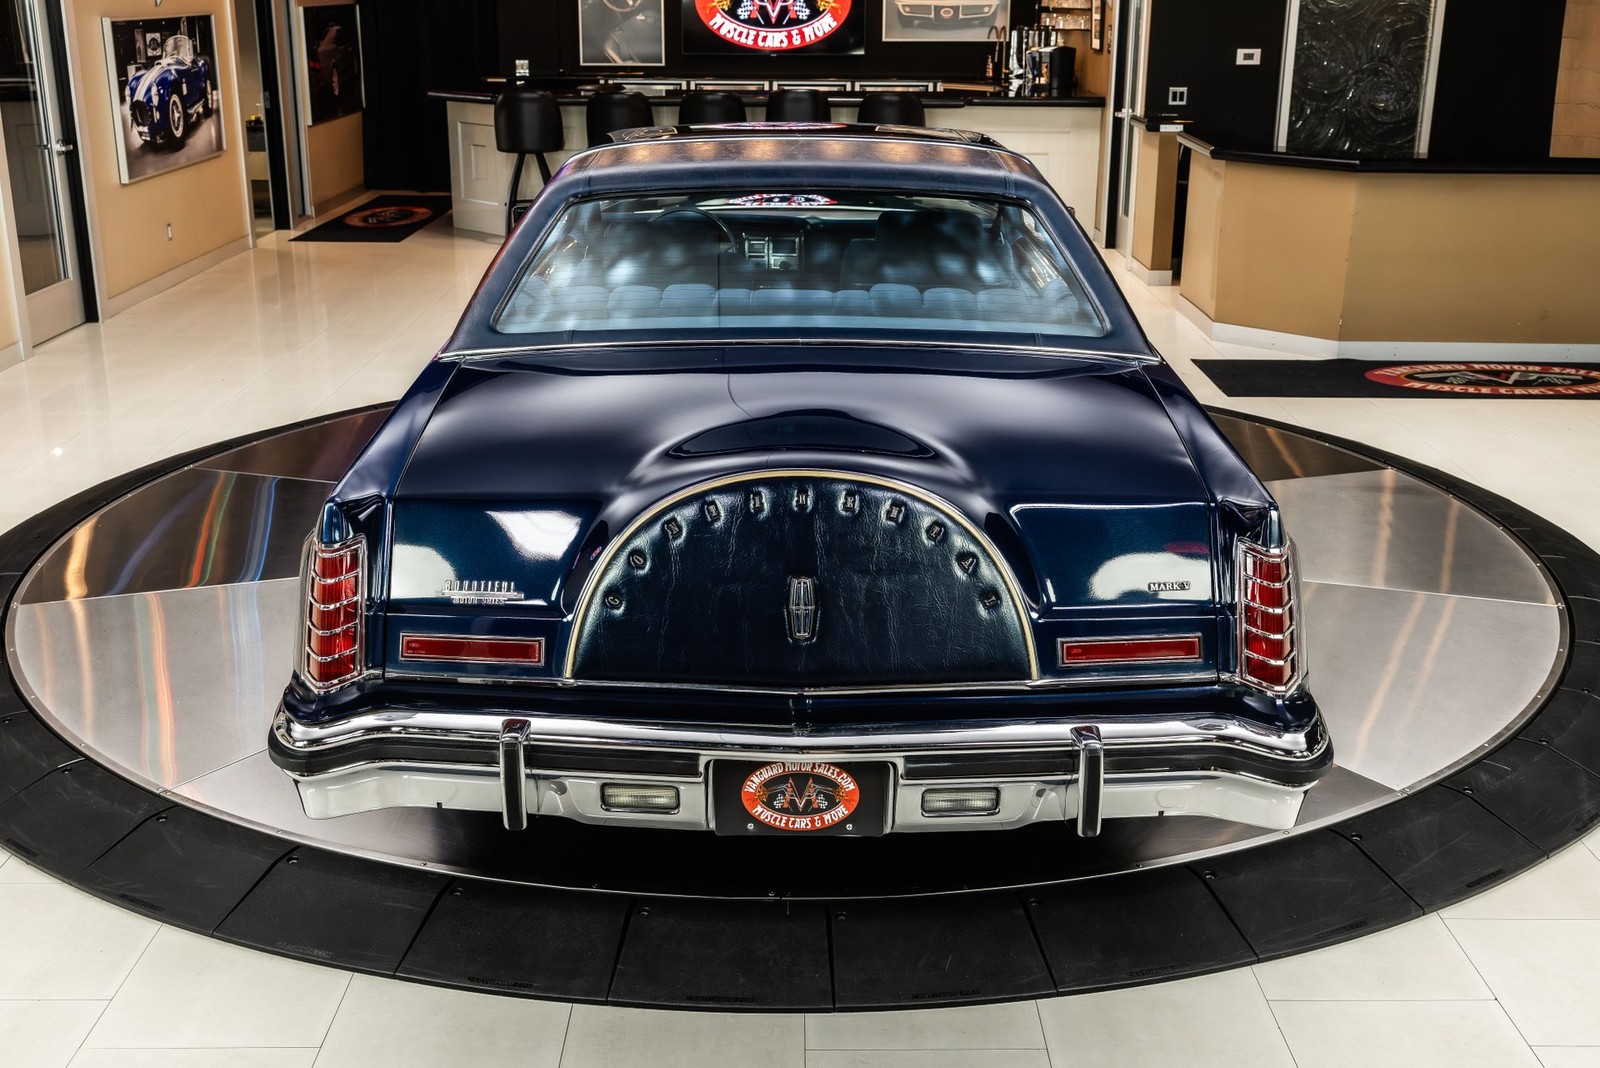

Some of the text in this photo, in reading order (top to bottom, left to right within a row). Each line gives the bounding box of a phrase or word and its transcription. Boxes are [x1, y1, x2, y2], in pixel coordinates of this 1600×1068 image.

[709, 13, 837, 48] MUSCLE CARS & MORE
[1403, 381, 1492, 393] MUSCLE
[1499, 386, 1554, 394] CARS
[445, 580, 515, 592] BOUNTIFUL
[1149, 581, 1190, 591] MARK V
[744, 761, 855, 793] VANGUARD MOTOR SALES.COM
[752, 804, 849, 829] MUSCLE CARS & MORE
